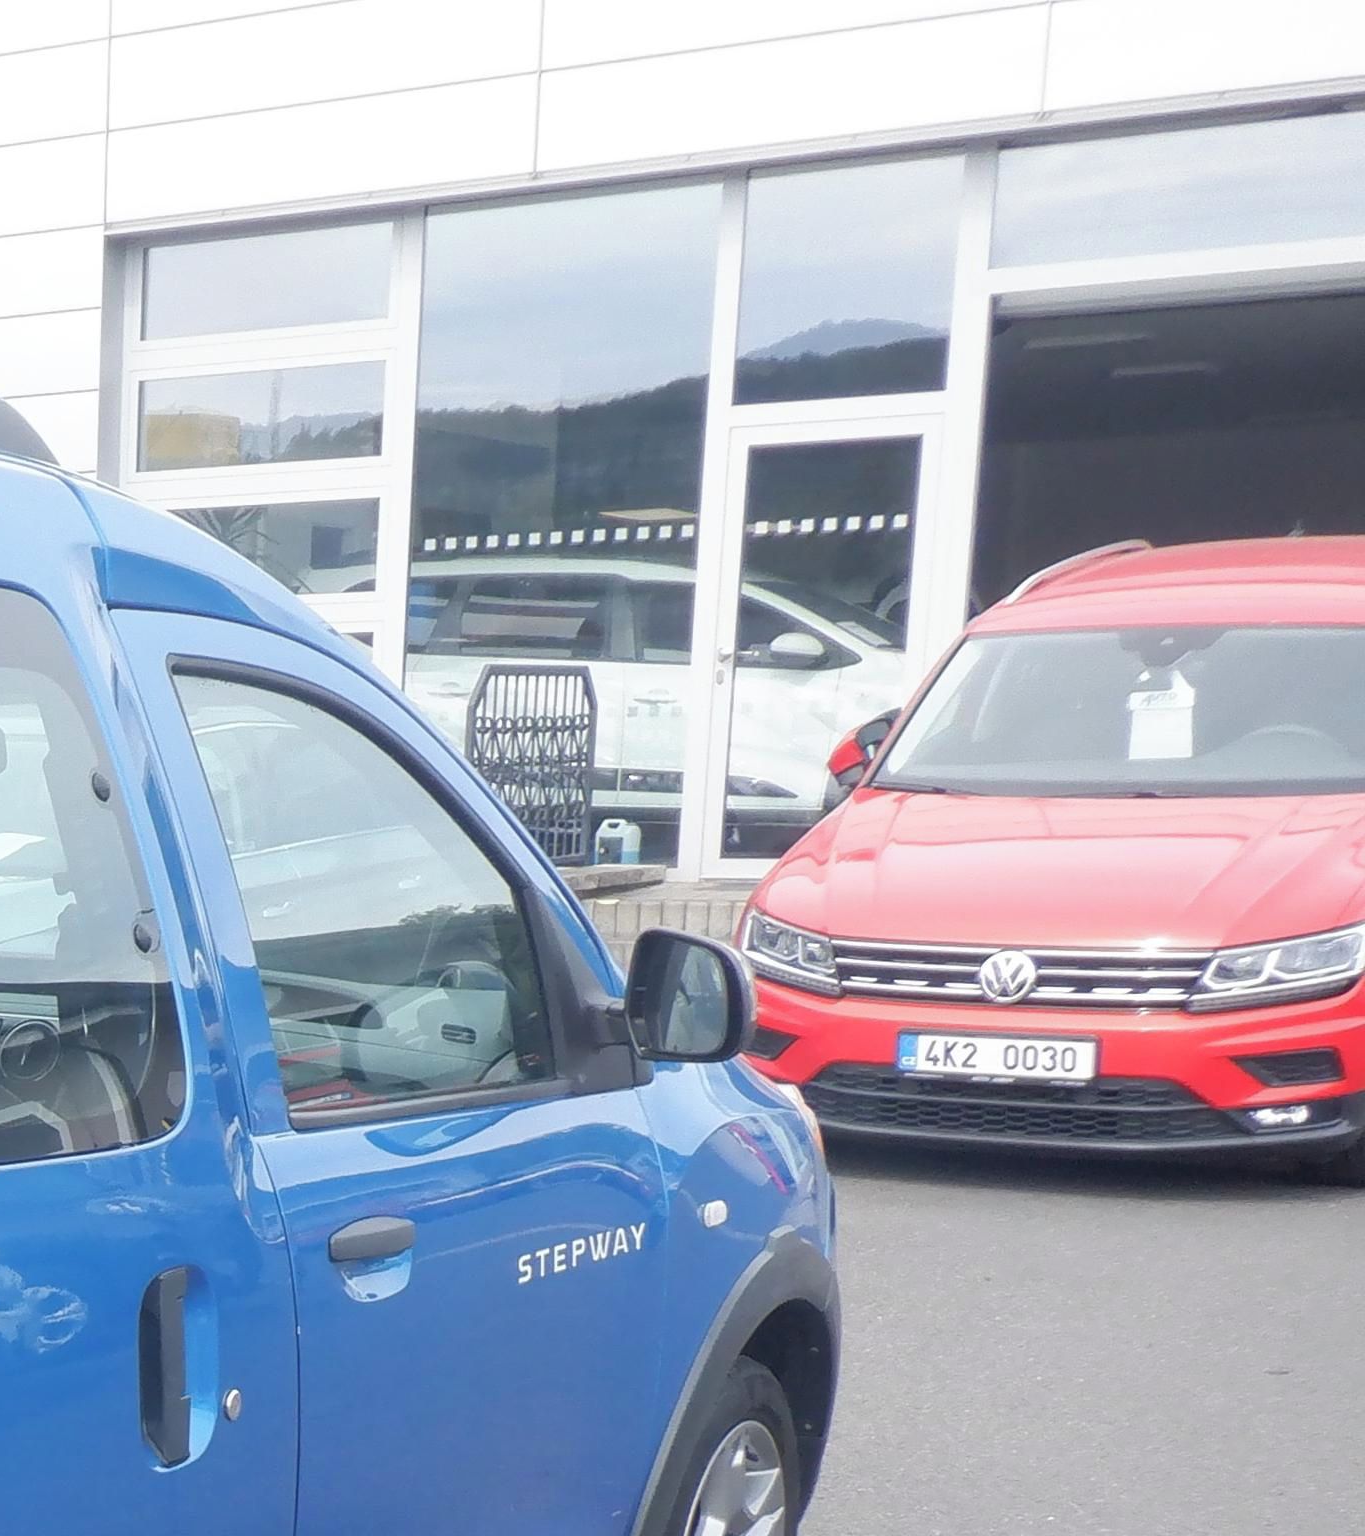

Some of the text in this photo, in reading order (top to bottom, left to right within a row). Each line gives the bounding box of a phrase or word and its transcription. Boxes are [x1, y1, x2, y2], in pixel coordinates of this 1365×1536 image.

[924, 1040, 1077, 1072] 4K2 0030
[517, 1222, 646, 1284] STEPWAY
